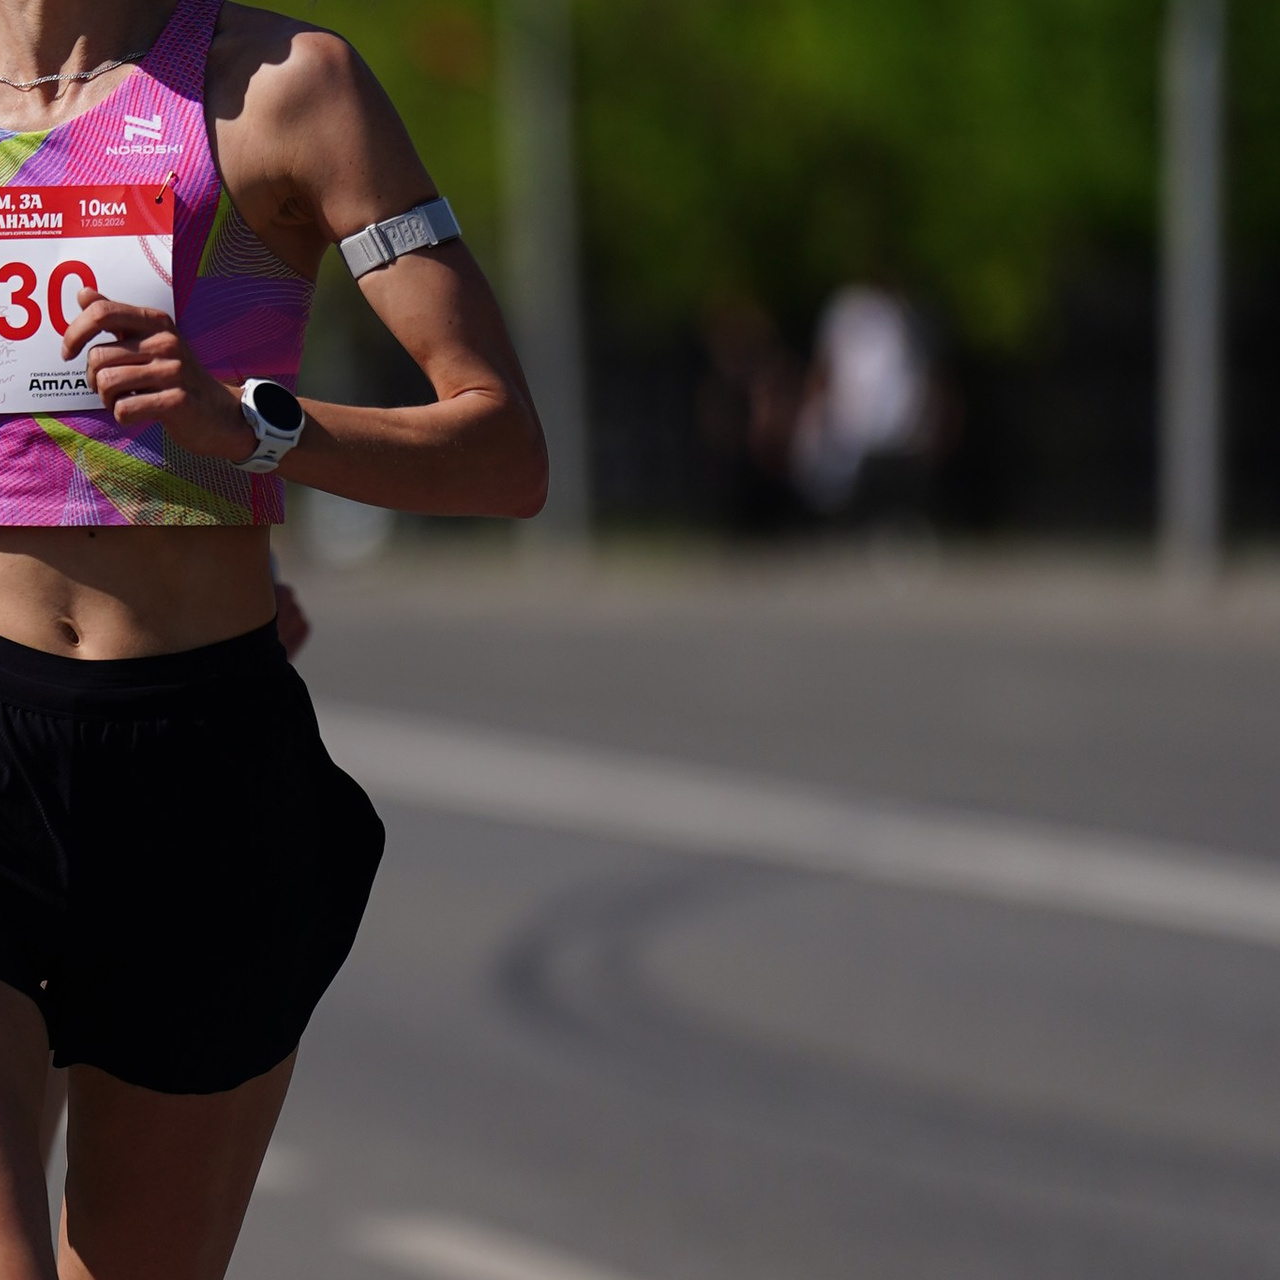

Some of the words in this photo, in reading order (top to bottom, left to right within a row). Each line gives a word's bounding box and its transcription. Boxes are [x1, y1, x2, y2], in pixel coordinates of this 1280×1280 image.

[106, 144, 183, 155] NORDSKI
[19, 193, 43, 209] ЗА
[80, 218, 125, 228] 17.05.2026
